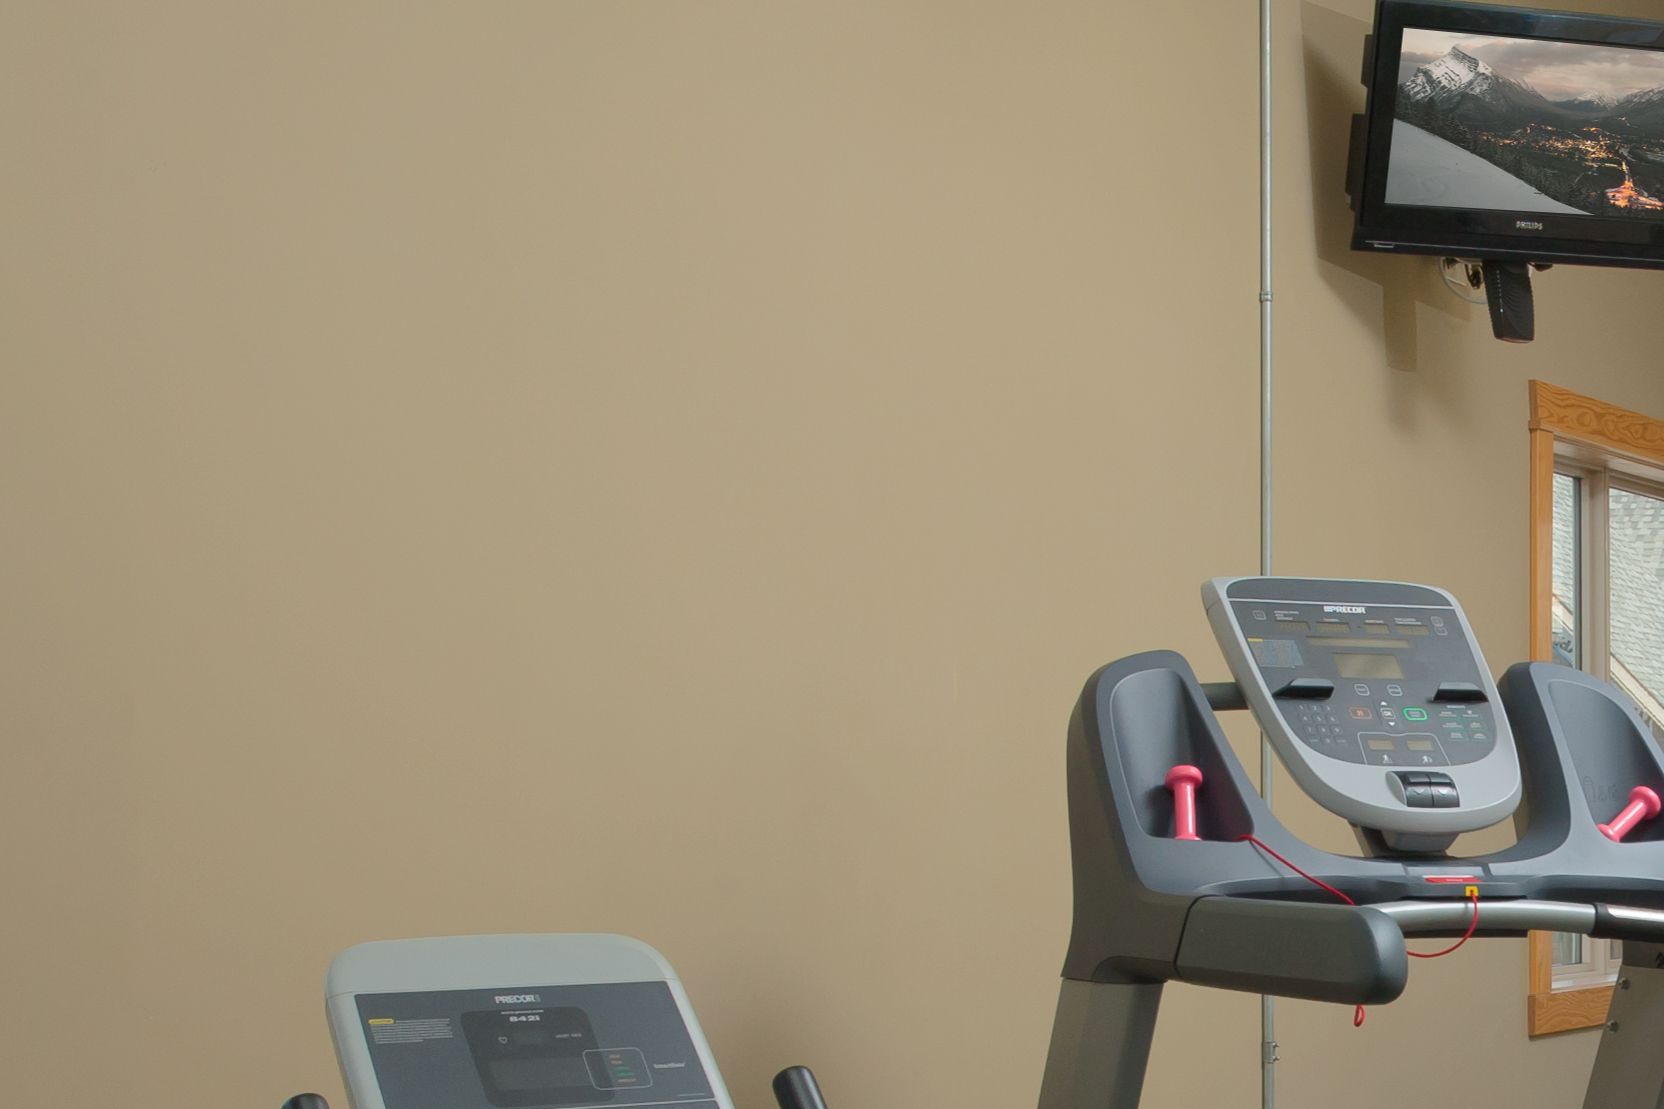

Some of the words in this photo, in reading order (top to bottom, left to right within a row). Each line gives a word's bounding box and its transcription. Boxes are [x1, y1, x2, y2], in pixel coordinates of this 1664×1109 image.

[1516, 221, 1543, 230] PHILIPS
[1328, 606, 1366, 614] PRECOR
[494, 995, 536, 1004] PRECOR
